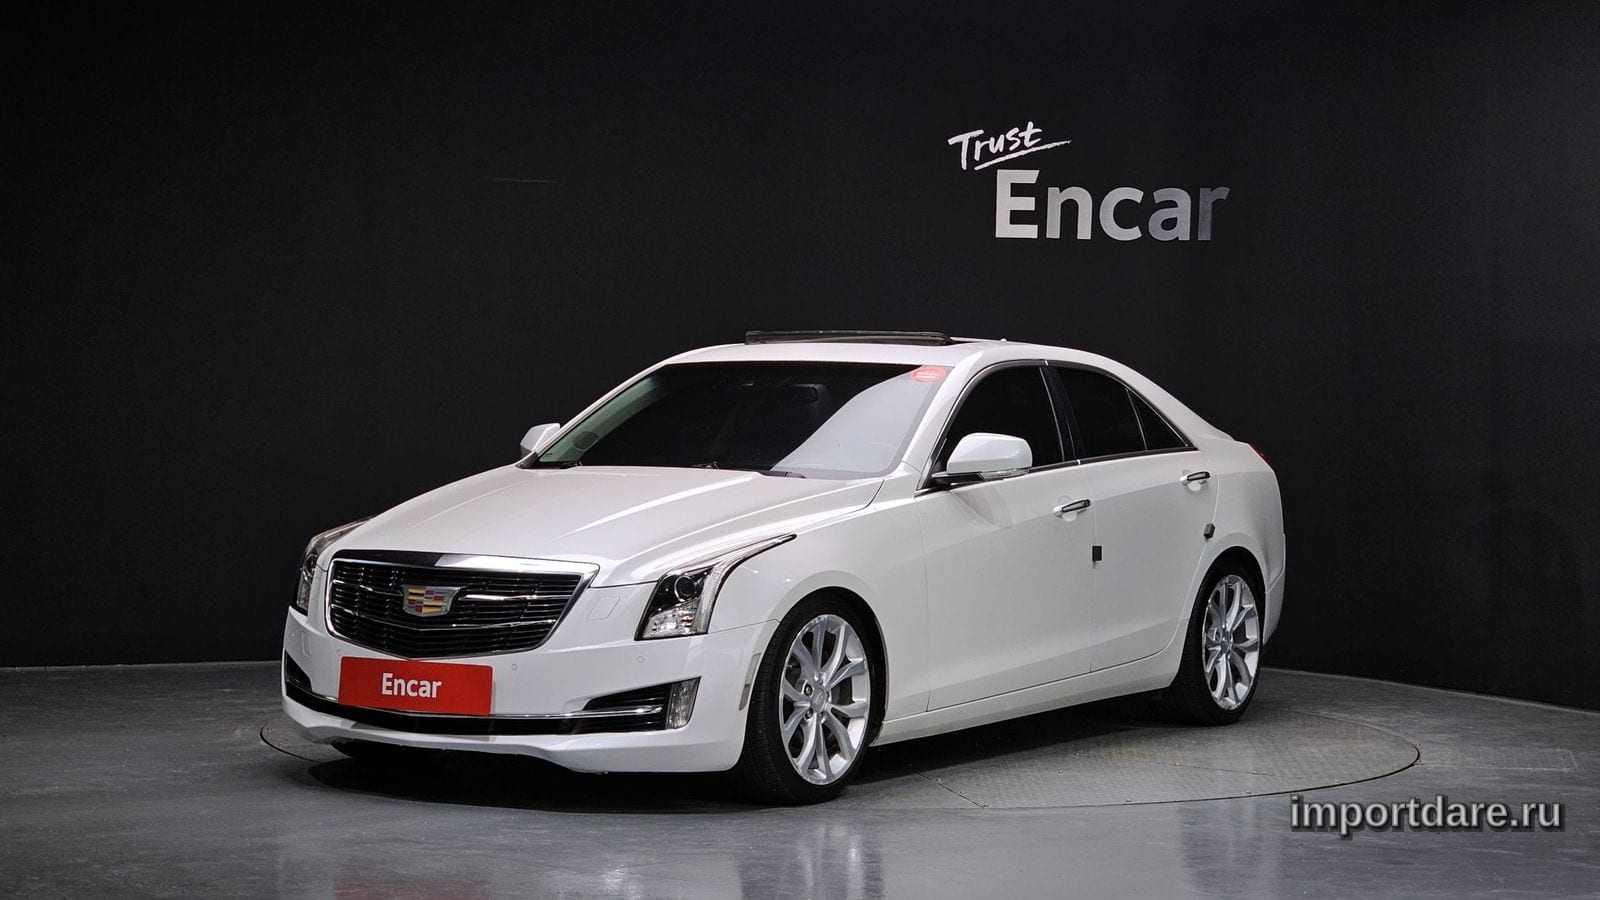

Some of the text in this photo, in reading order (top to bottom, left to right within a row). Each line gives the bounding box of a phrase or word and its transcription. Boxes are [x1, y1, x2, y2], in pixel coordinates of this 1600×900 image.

[948, 121, 1043, 170] Trust
[995, 169, 1231, 241] Encar
[381, 672, 442, 699] Encar
